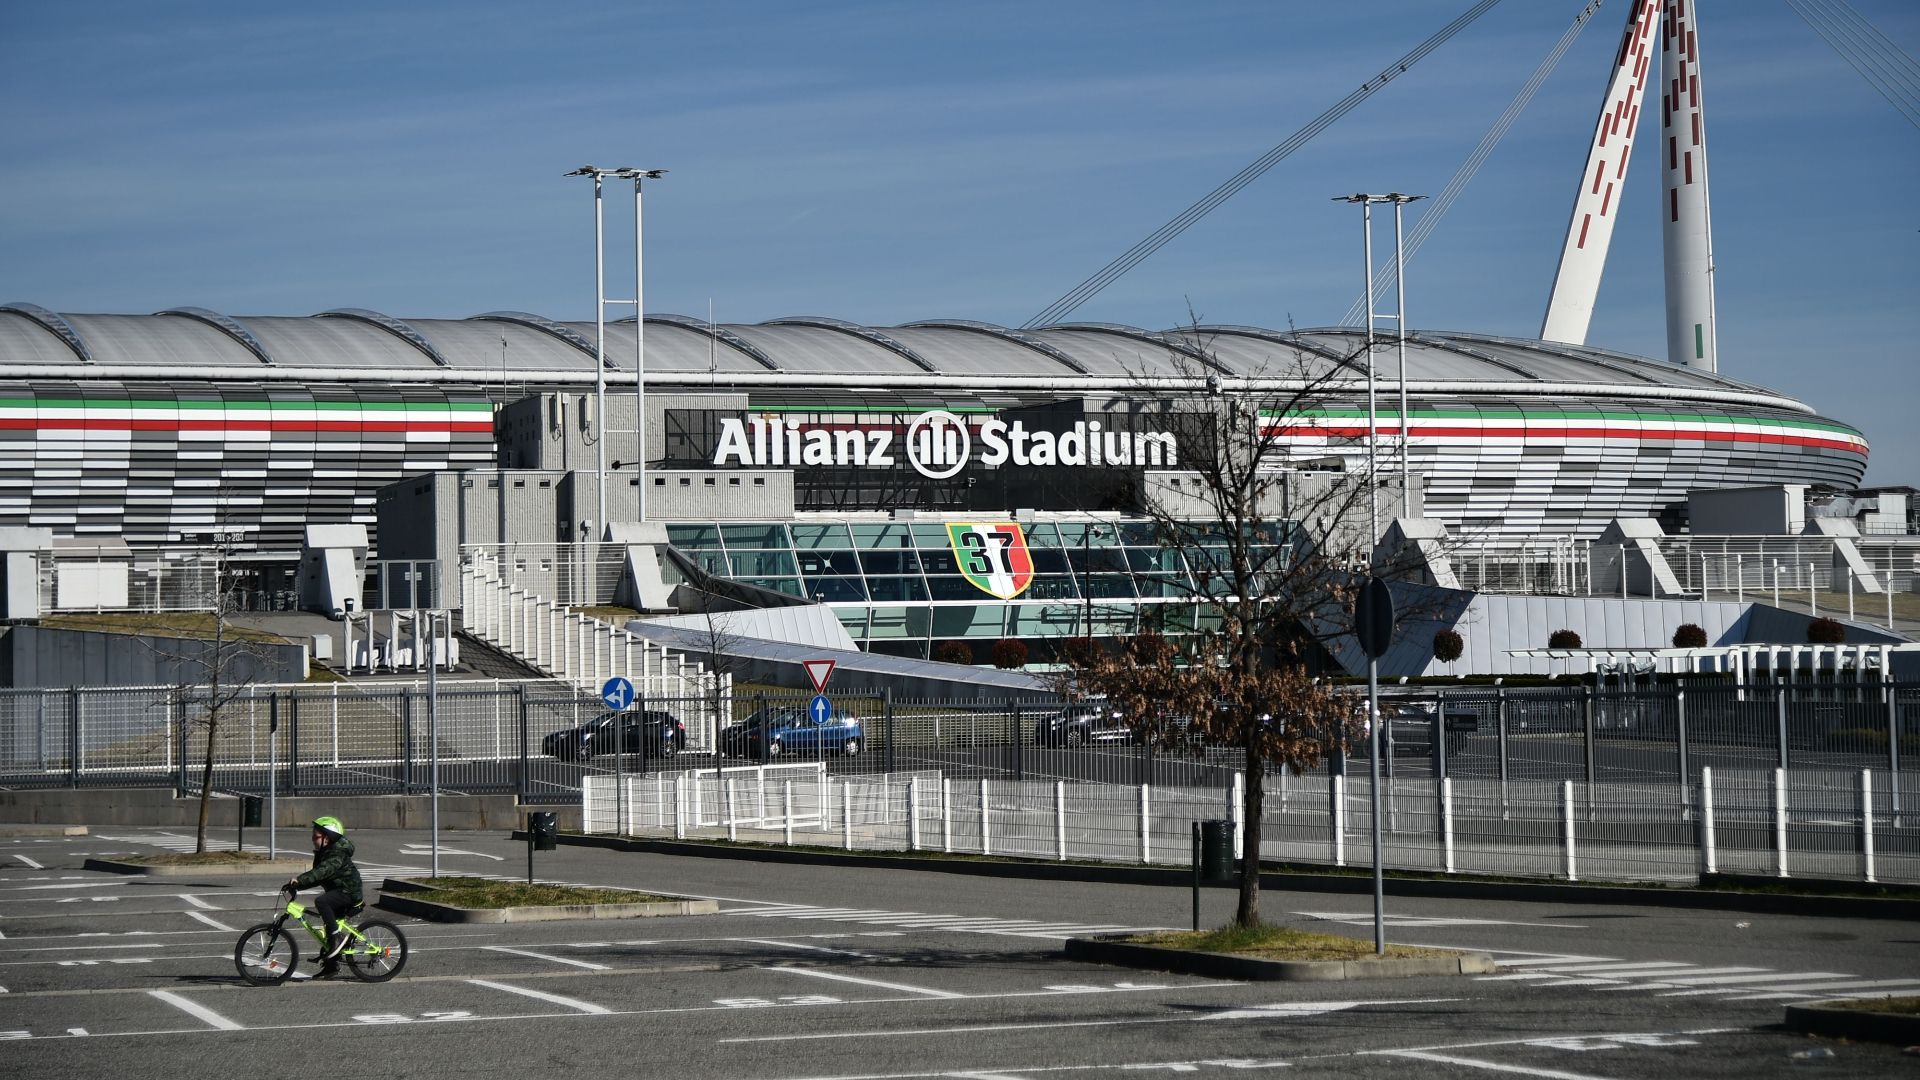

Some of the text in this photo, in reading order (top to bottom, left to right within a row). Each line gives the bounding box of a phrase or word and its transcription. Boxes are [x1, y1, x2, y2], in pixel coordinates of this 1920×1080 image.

[713, 418, 1178, 466] Allianz Stadium
[961, 532, 1015, 576] 37
